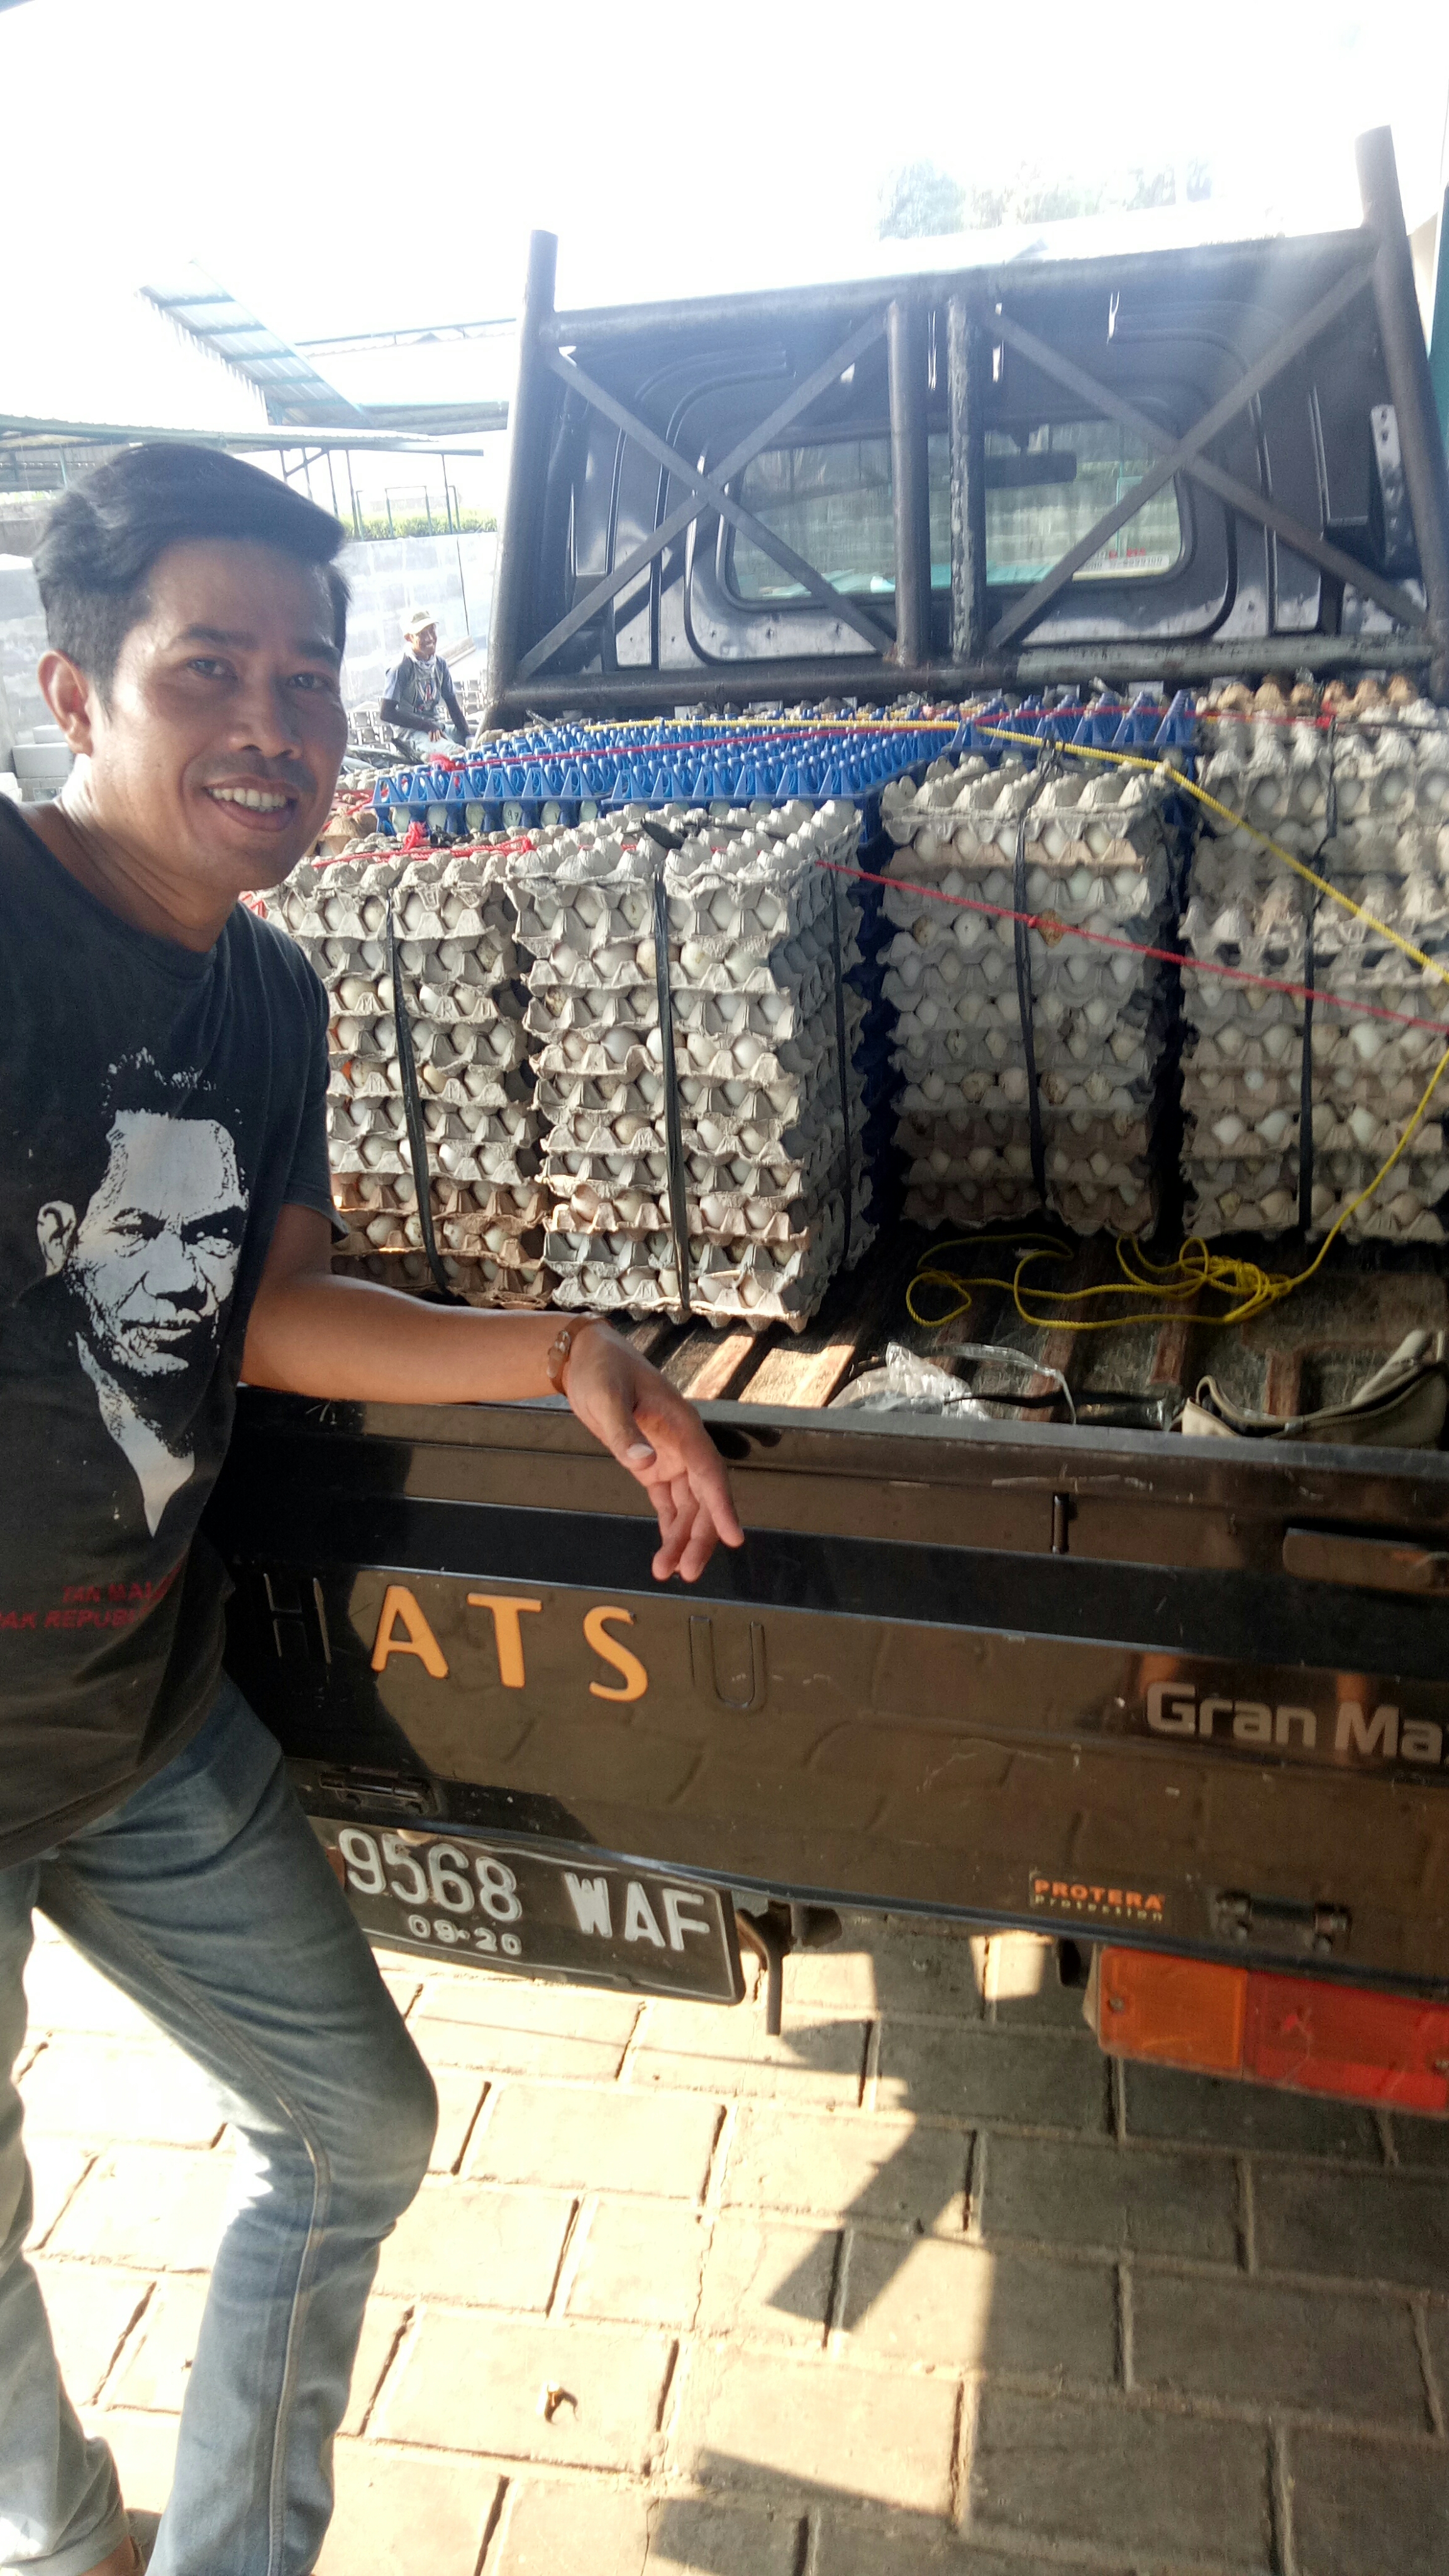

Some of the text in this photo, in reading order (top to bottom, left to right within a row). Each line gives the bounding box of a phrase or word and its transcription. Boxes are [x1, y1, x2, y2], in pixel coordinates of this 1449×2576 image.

[0, 1610, 38, 1629] AK
[1146, 1681, 1449, 1764] Gran Ma
[338, 1828, 710, 1951] 9568 WAF
[1034, 1879, 1163, 1911] PROTERA
